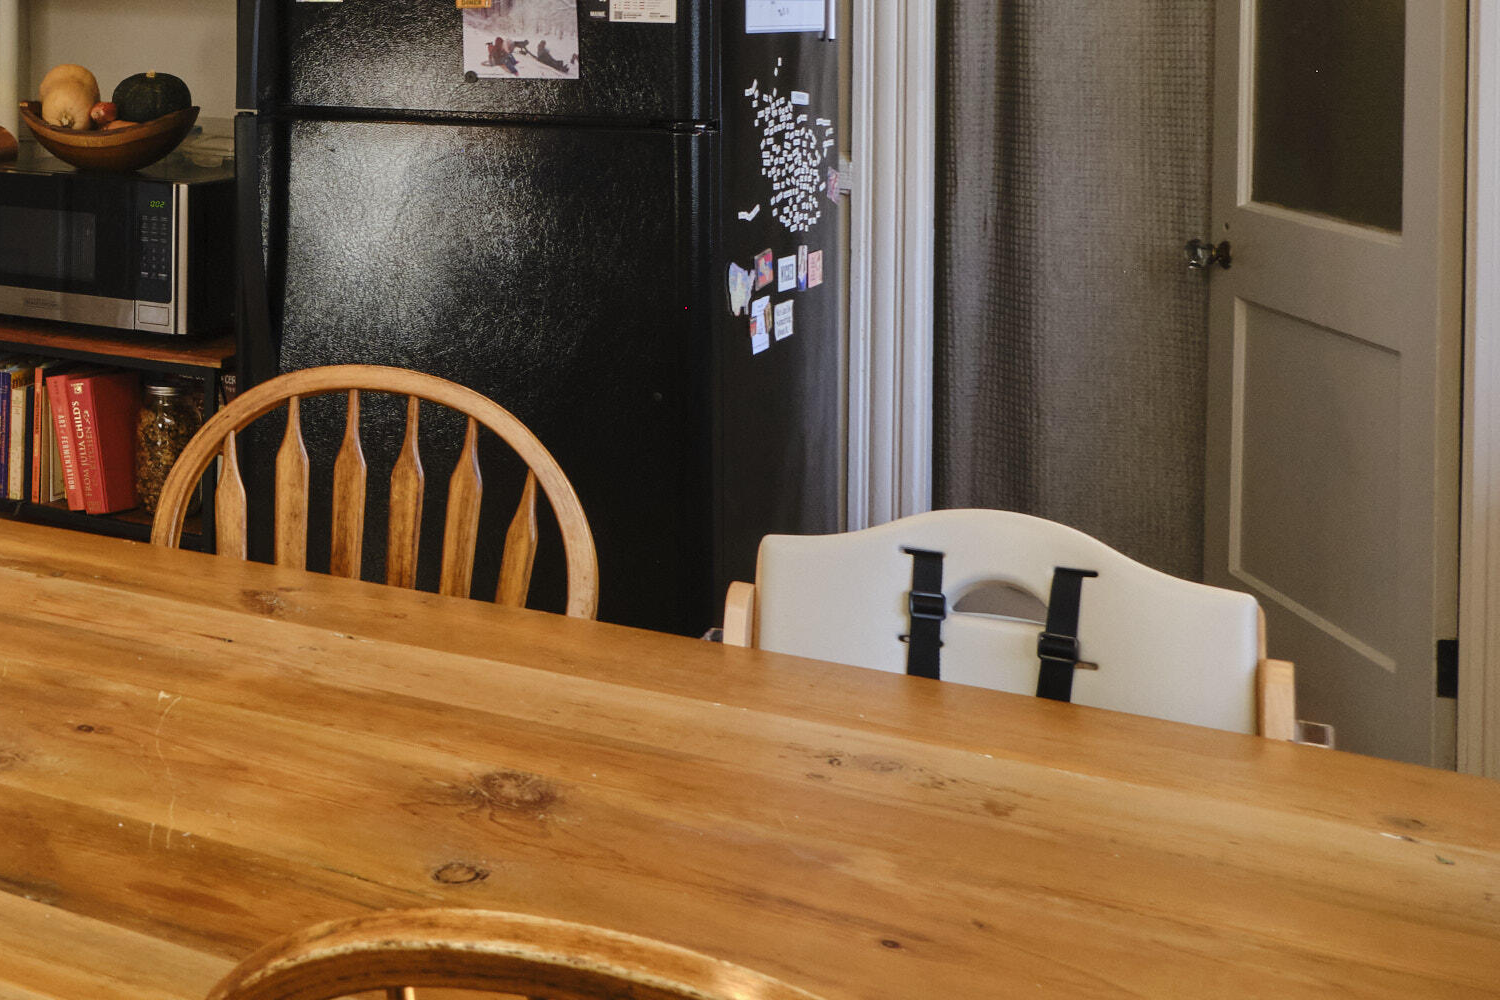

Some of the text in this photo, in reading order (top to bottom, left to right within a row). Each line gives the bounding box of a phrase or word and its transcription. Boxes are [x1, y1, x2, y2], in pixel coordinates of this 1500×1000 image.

[61, 435, 76, 490] FERMENTATION
[71, 400, 93, 497] FROM JULIA CHILD'S
